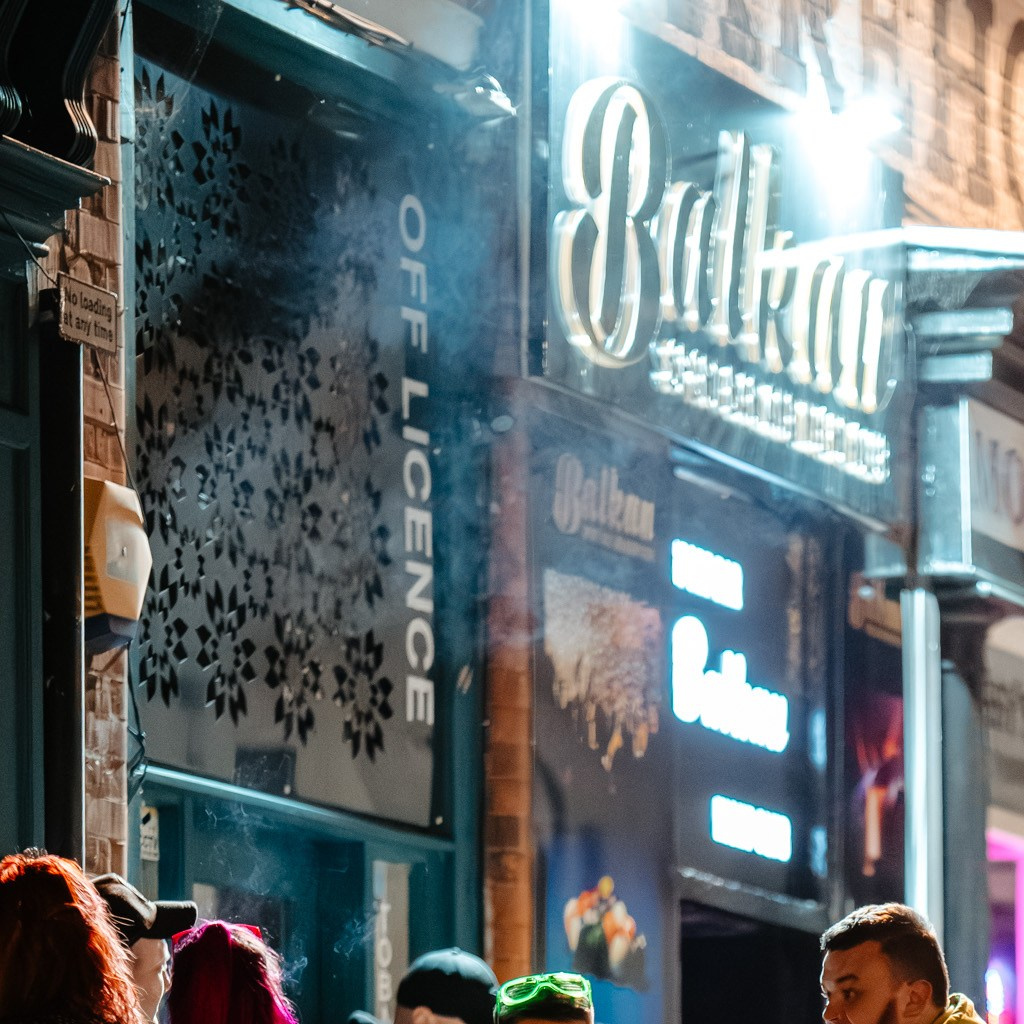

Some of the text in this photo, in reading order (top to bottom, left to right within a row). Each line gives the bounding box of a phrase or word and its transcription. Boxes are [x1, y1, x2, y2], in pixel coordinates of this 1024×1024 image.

[63, 311, 113, 343] at any time
[64, 286, 112, 323] No loading
[548, 76, 898, 414] Balkan
[400, 194, 435, 726] OFF LICENCE
